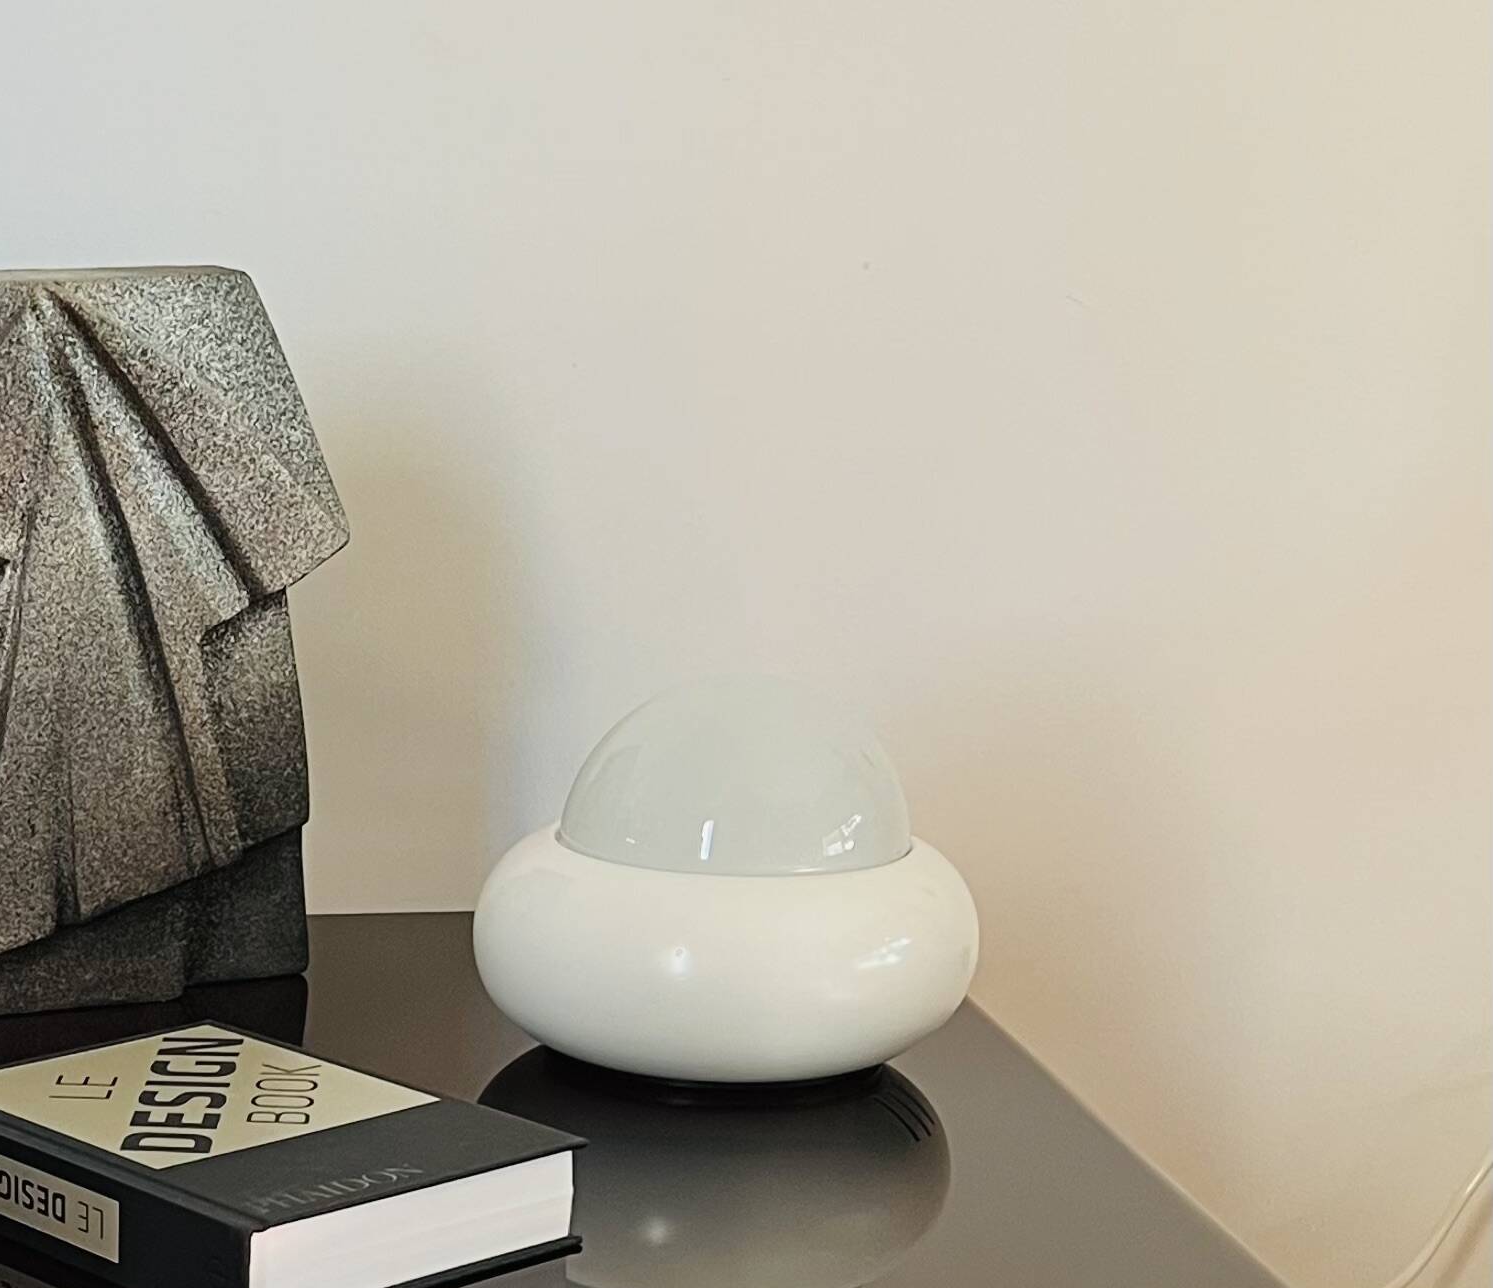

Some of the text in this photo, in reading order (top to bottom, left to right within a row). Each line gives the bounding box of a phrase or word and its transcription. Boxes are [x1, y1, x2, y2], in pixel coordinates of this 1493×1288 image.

[48, 1075, 118, 1100] LE
[120, 1037, 244, 1154] DESIGN
[246, 1063, 322, 1125] BOOK
[77, 1201, 104, 1240] LE
